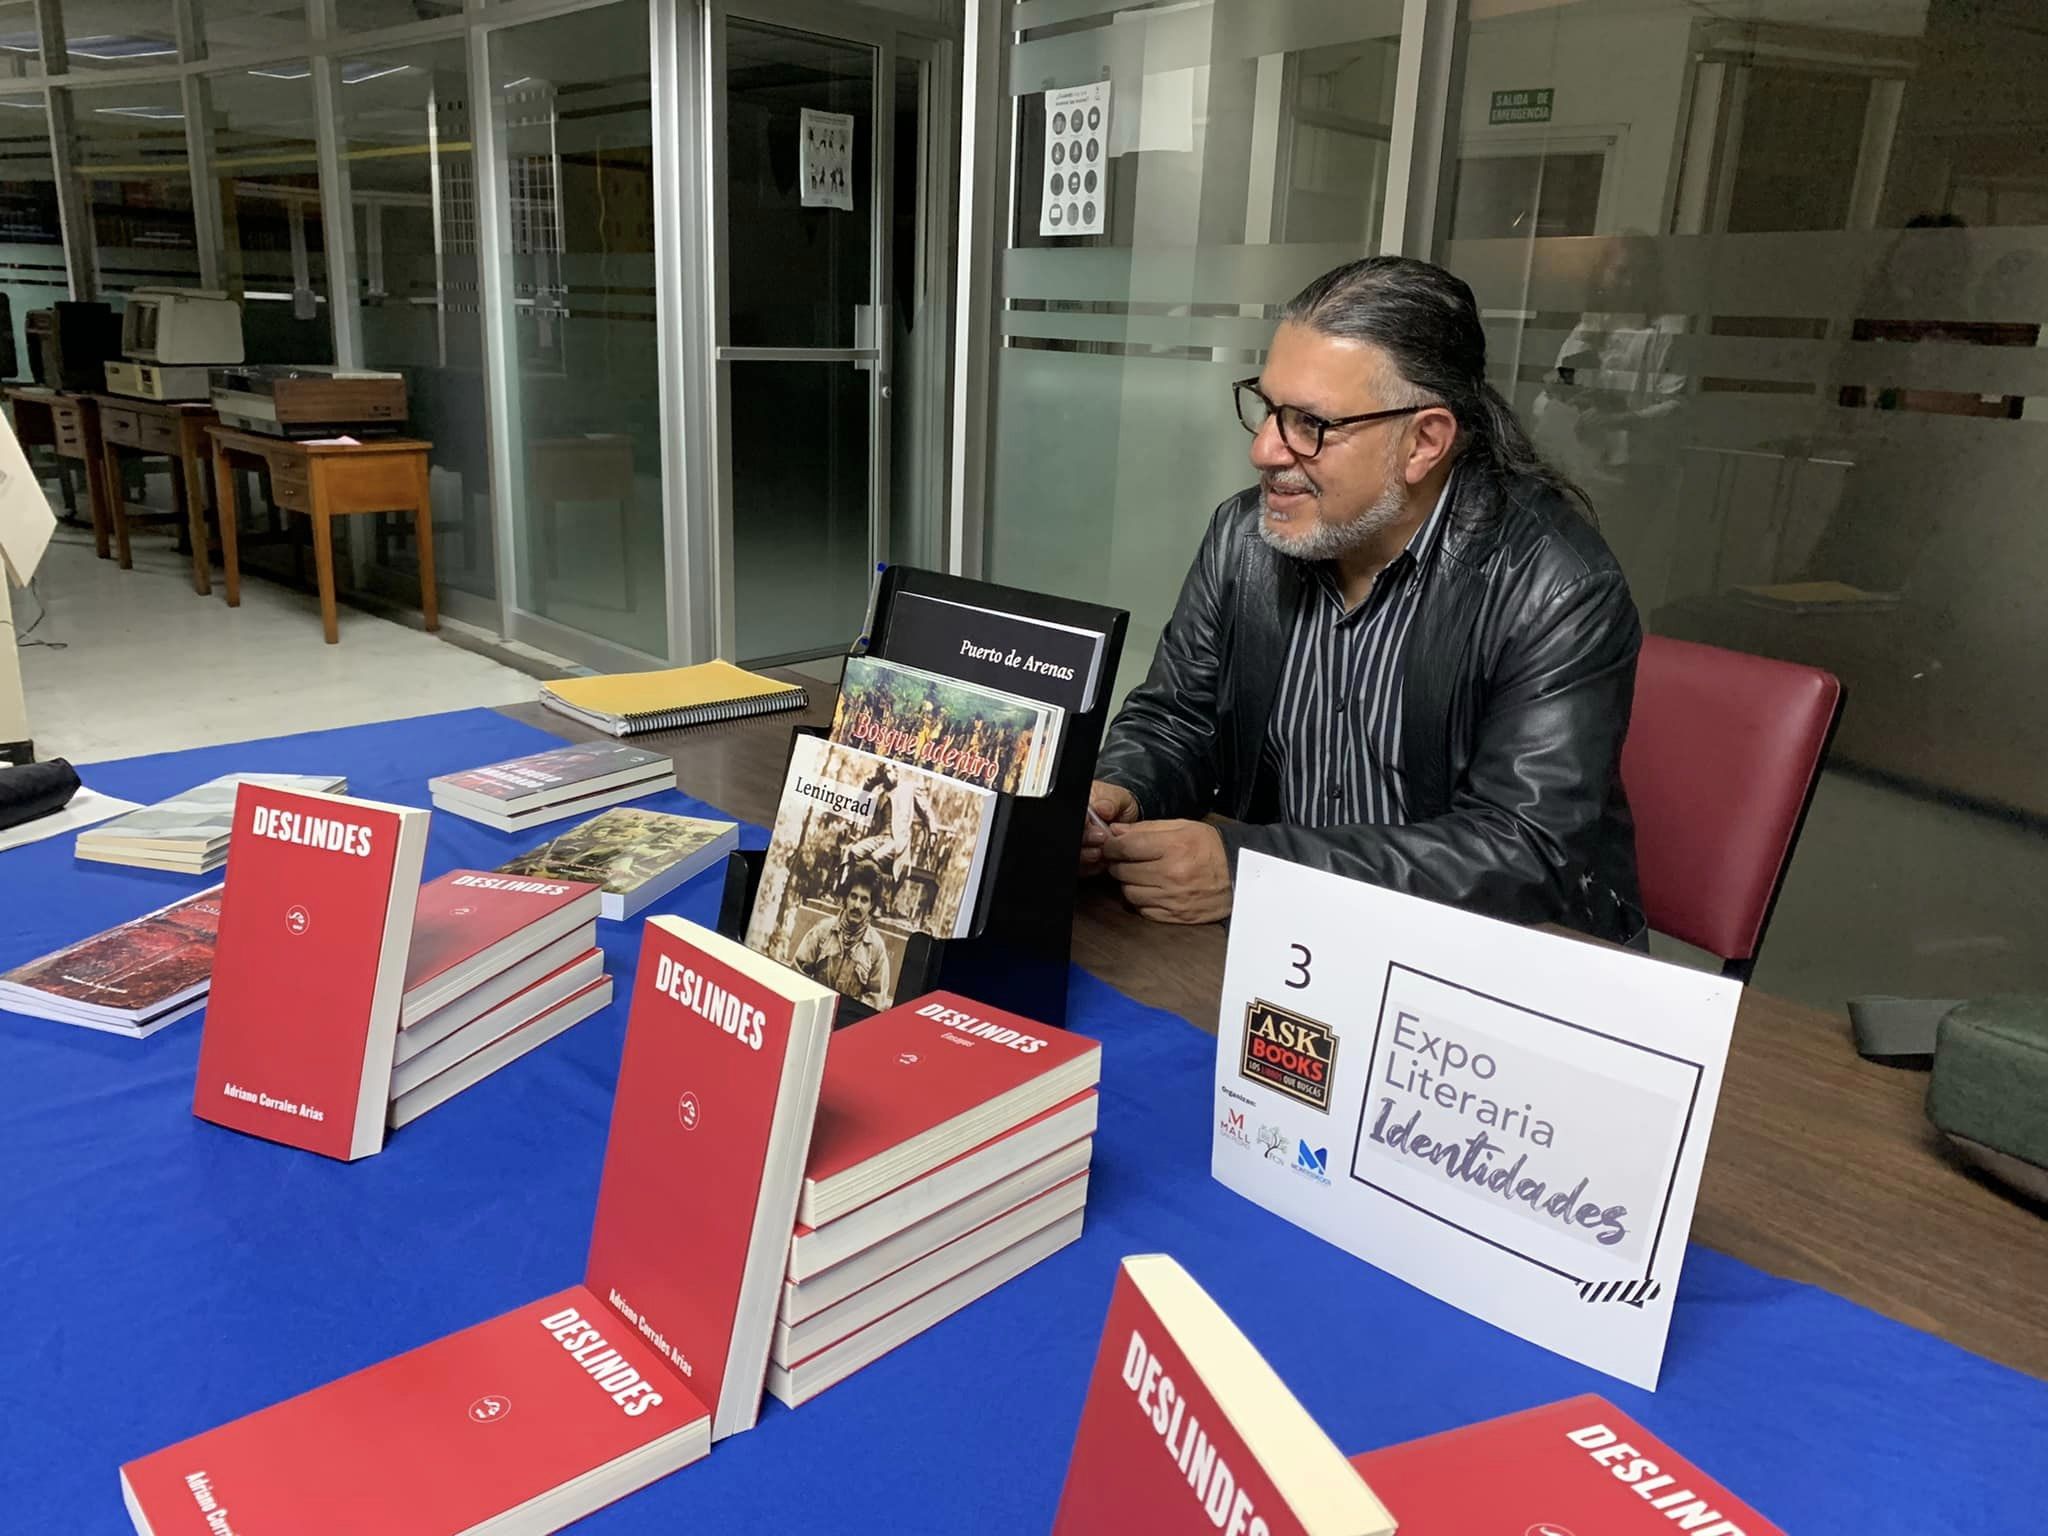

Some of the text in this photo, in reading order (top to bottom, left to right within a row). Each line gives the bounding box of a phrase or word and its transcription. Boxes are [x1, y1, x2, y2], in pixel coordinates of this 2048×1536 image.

[960, 639, 1075, 681] Puerto de Arenas
[853, 712, 1000, 782] Bosque adentro
[795, 776, 872, 816] Leningrad
[252, 805, 373, 857] DESLINDES
[451, 875, 571, 896] DESLINDES
[1284, 943, 1312, 989] 3
[655, 953, 766, 1050] DESLINDES
[915, 1003, 1048, 1053] DESLINDES
[1259, 1015, 1320, 1058] ASK
[1393, 1011, 1496, 1080] Expo
[1252, 1037, 1324, 1082] BOOKS
[1283, 1075, 1297, 1088] QUE
[223, 1083, 324, 1122] Adriano Corrales Arias
[1385, 1050, 1554, 1148] Literaria
[1220, 1120, 1251, 1145] MALL
[1369, 1097, 1631, 1246] Identidades
[608, 1287, 693, 1378] Adriano Corrales Arias
[540, 1307, 664, 1417] DESLINDES
[184, 1471, 240, 1536] Adriano Corr
